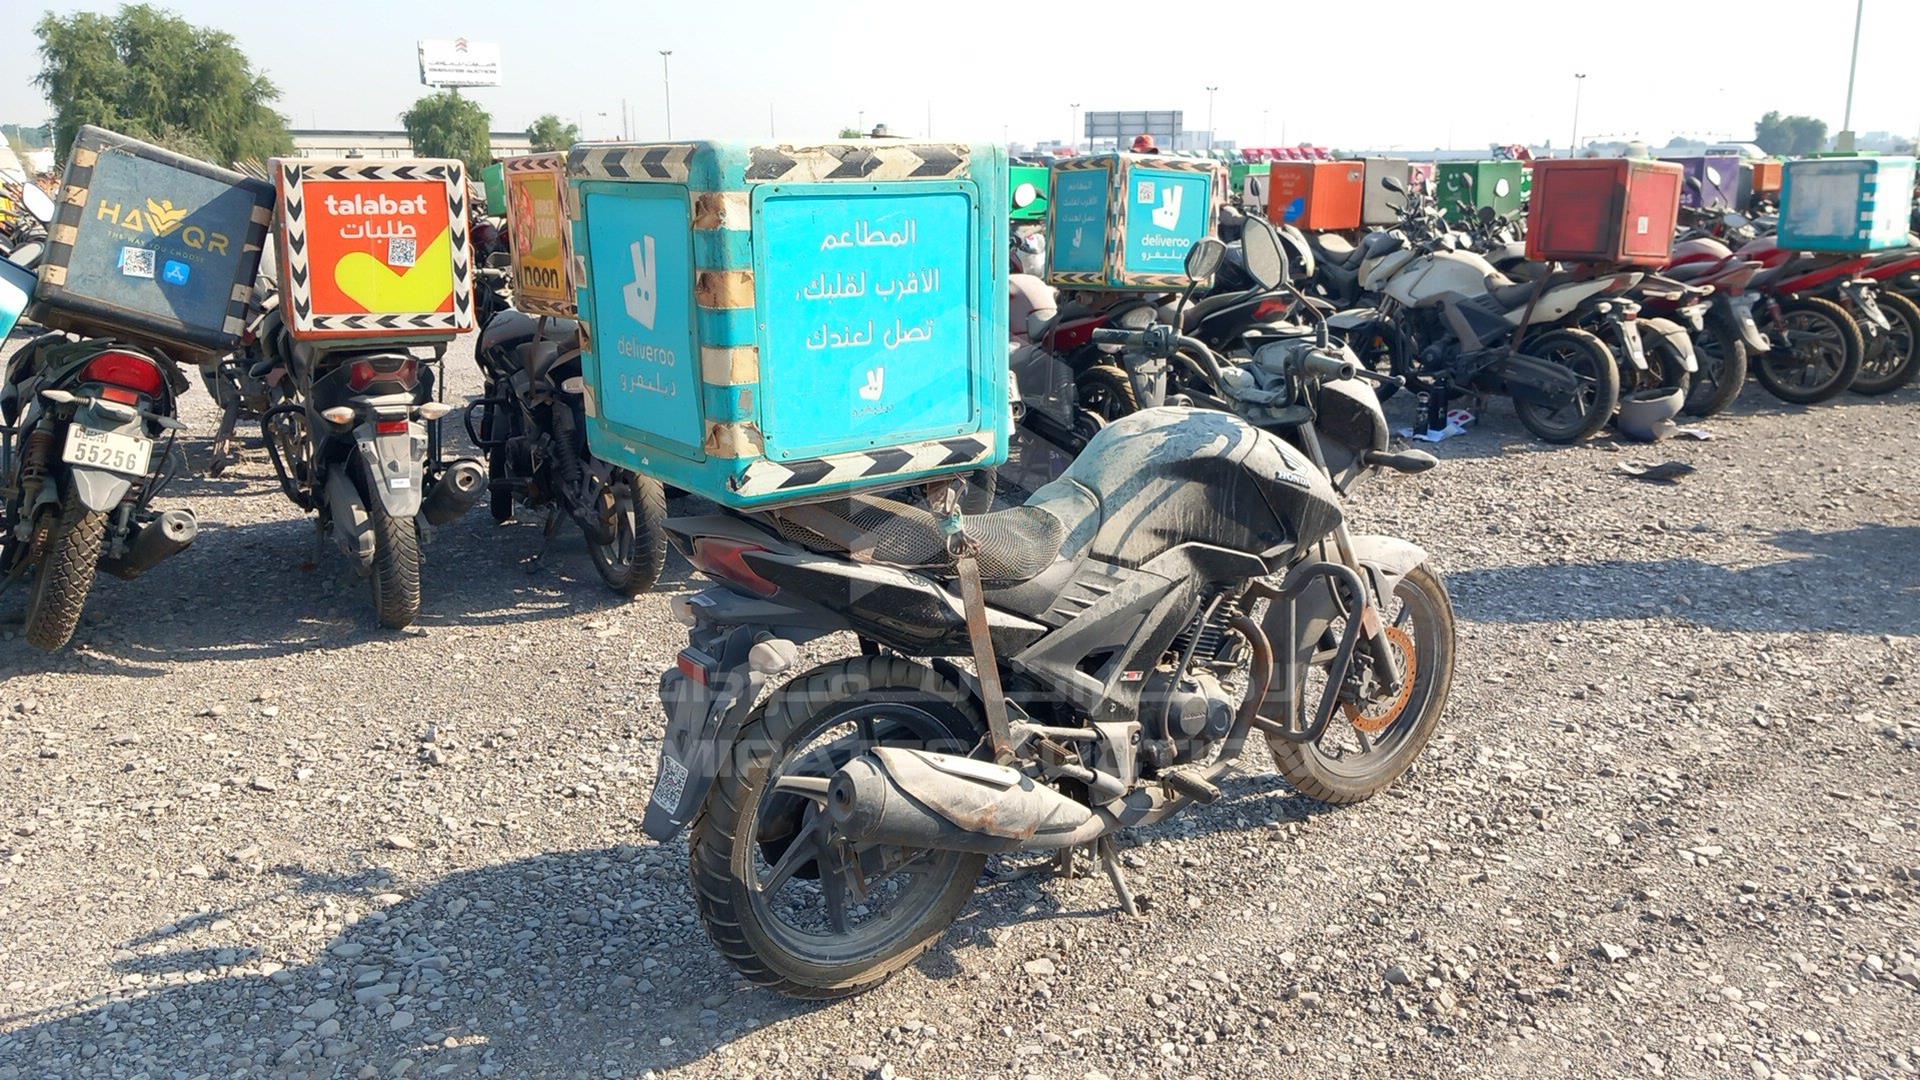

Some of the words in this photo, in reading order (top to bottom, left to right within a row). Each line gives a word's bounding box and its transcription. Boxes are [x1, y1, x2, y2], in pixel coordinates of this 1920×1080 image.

[324, 193, 428, 216] talabat
[339, 220, 417, 244] طلبات
[820, 217, 917, 252] المطاعم
[1141, 233, 1190, 248] deliveroo
[523, 265, 560, 290] noon
[876, 266, 940, 301] الأقرب
[806, 320, 873, 350] لعندك
[883, 316, 934, 350] تصل
[617, 335, 677, 368] deliveroo
[74, 442, 137, 471] 55256
[1276, 470, 1311, 489] HONDA
